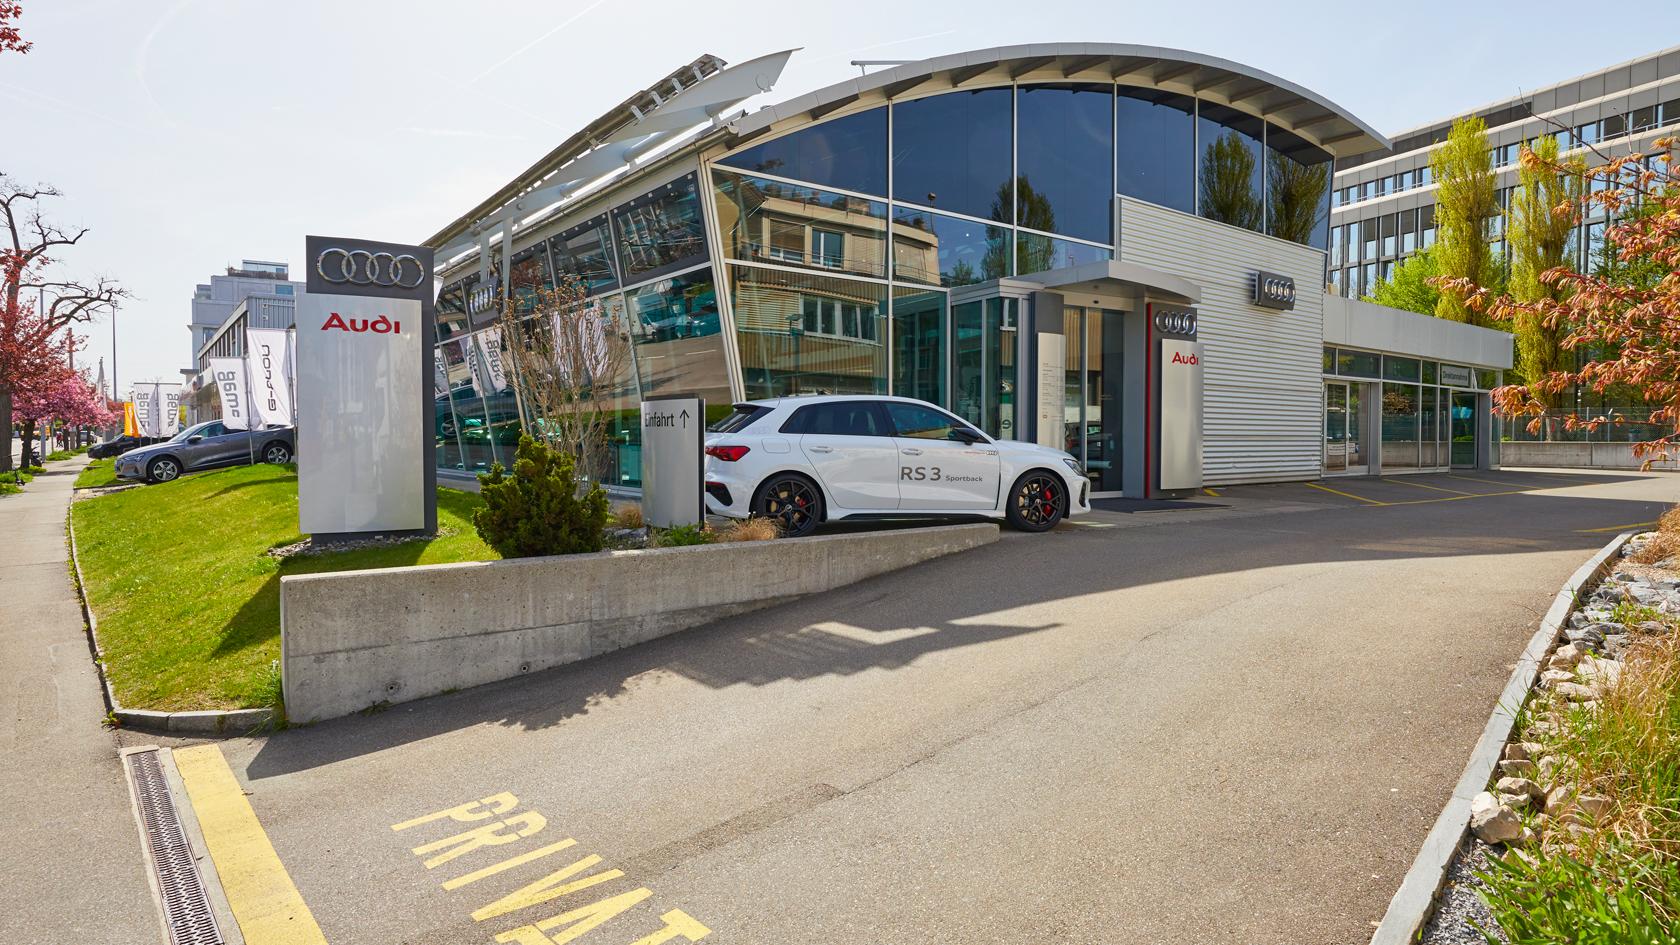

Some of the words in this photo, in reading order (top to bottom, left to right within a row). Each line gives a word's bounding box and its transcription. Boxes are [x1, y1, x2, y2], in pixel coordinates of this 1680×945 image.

[320, 312, 401, 334] Audi
[1172, 351, 1199, 366] Audi
[645, 411, 675, 427] Einfahrt
[900, 466, 926, 481] RS
[929, 466, 941, 481] 3
